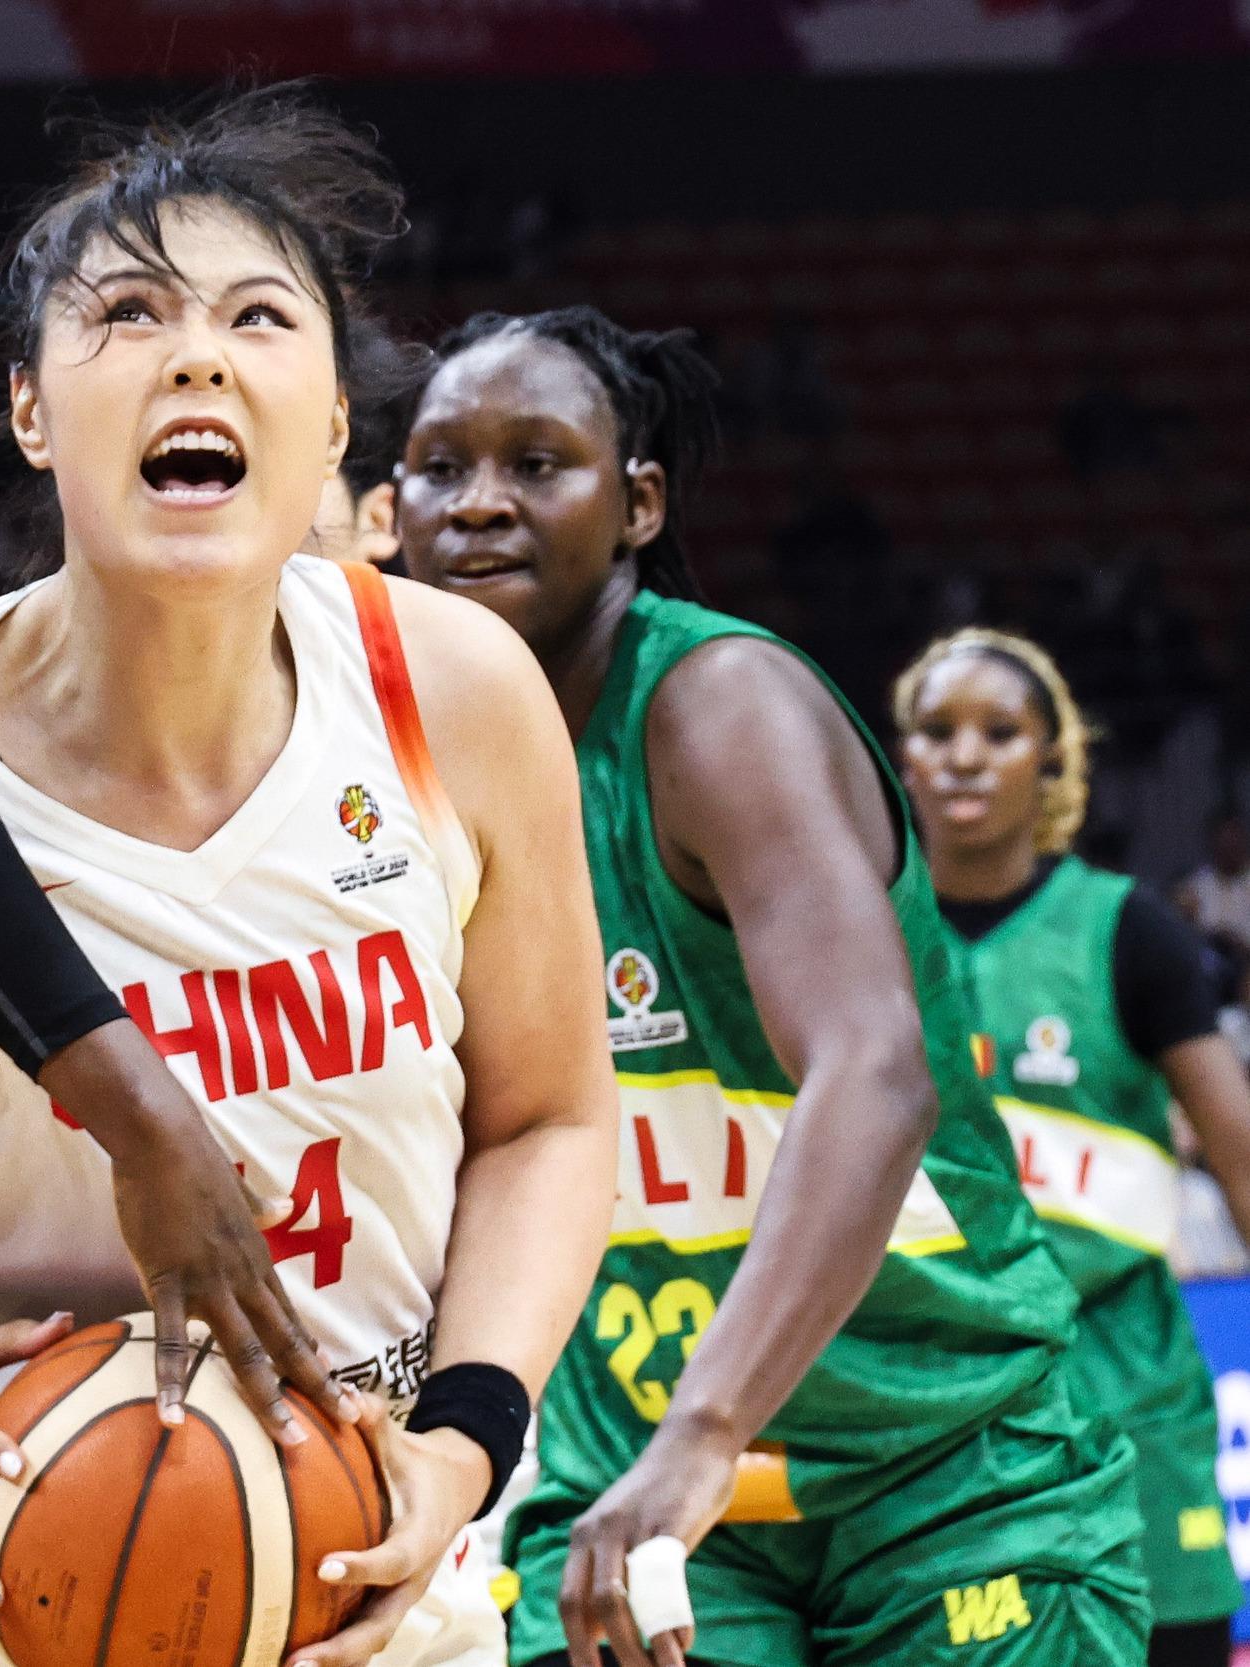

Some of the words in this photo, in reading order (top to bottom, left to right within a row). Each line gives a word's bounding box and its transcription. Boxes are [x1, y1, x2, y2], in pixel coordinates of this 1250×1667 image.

[51, 930, 432, 1131] HINA
[234, 1137, 353, 1291] 4
[616, 1115, 748, 1206] LI
